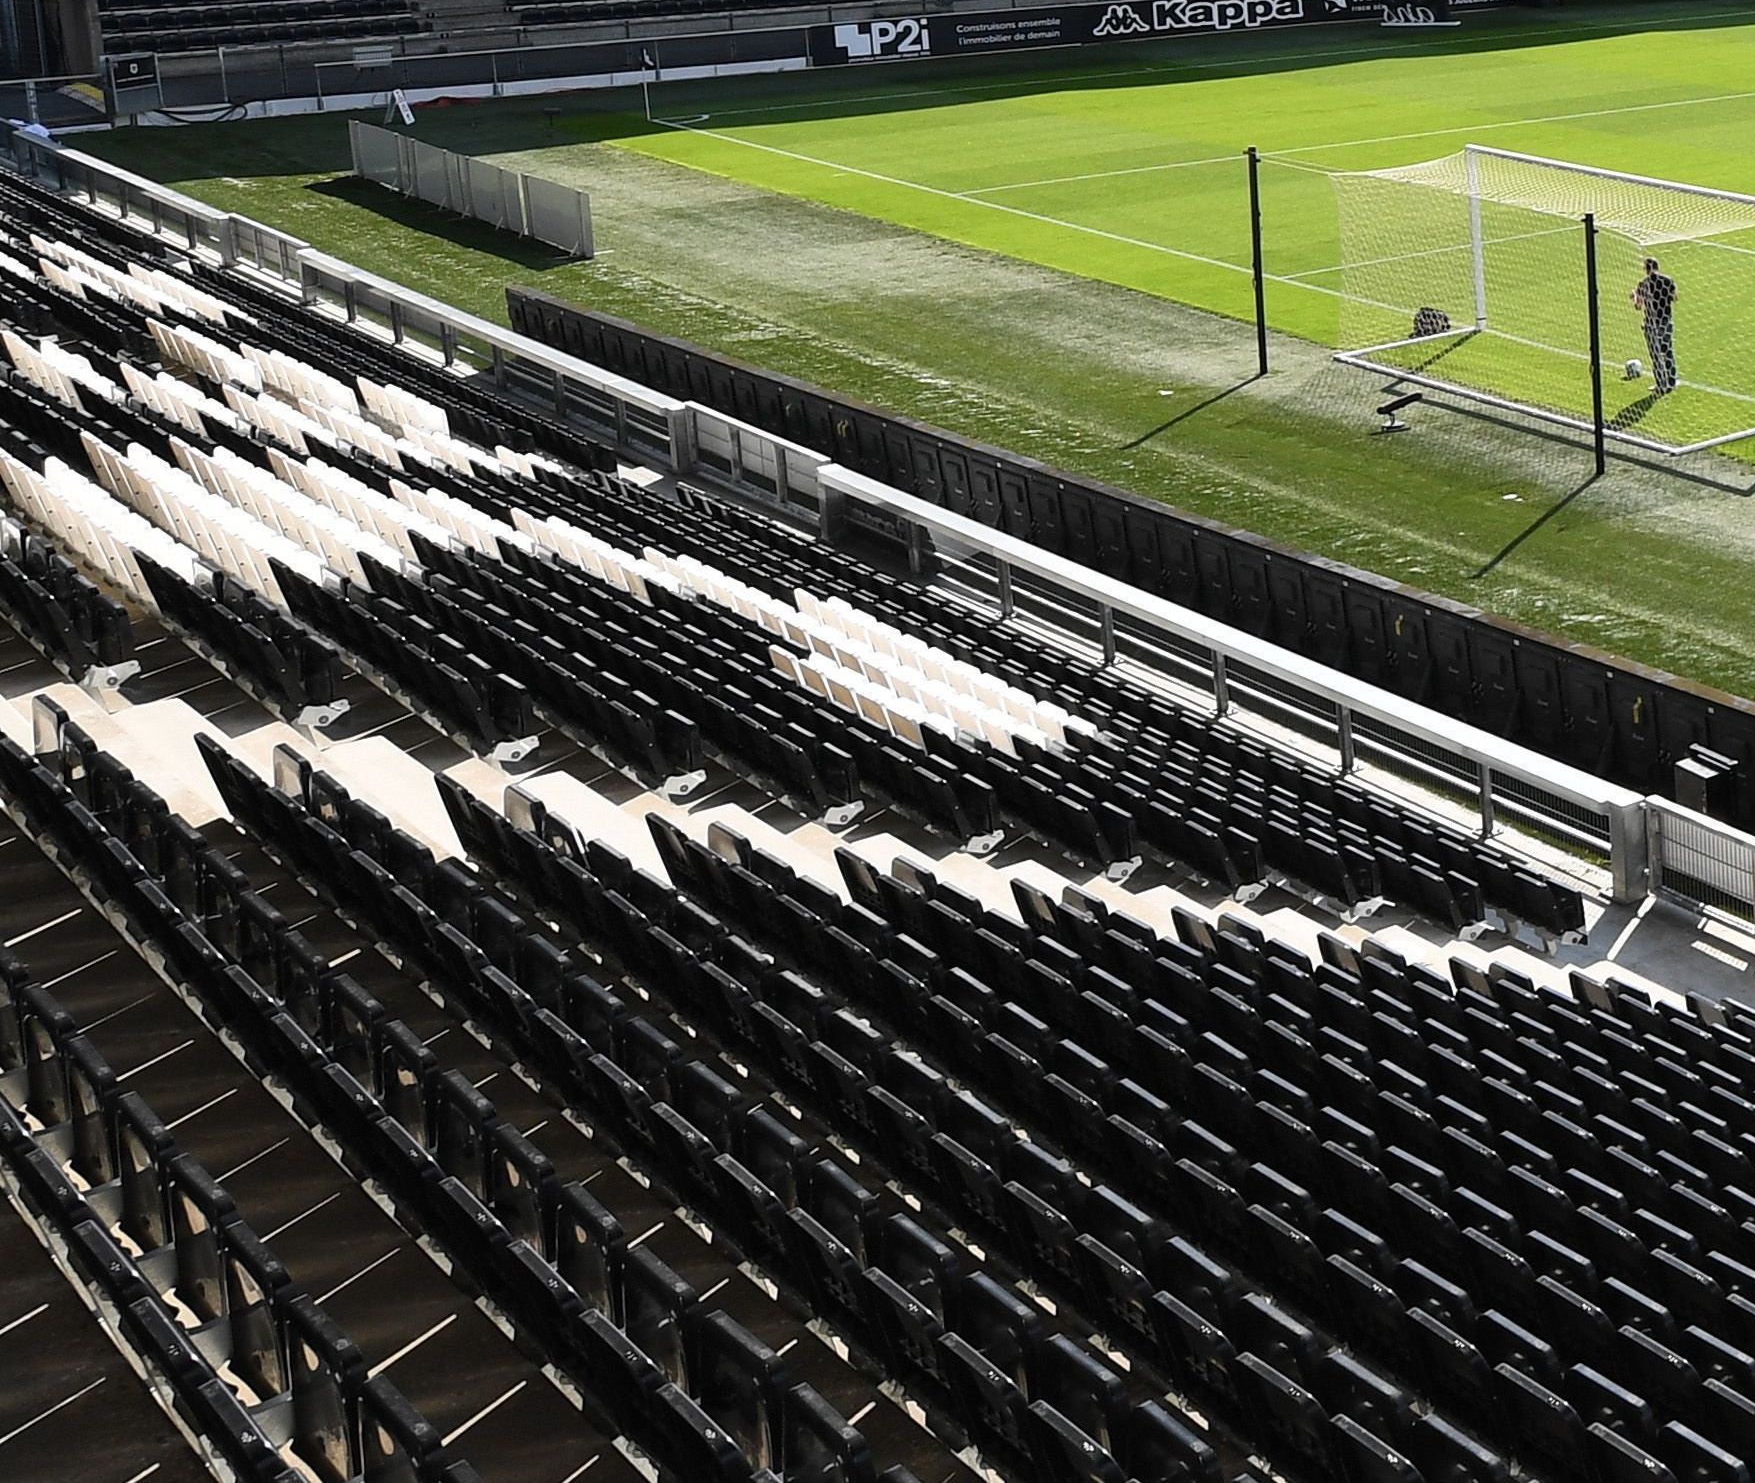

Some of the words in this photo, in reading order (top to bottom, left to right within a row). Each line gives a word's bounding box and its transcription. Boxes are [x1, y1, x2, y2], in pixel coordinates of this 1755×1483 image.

[956, 21, 1016, 34] Construisons
[1018, 17, 1061, 29] ensemble
[871, 18, 931, 54] P2i
[958, 32, 1012, 46] l'immobilier
[1014, 32, 1026, 42] de
[1027, 29, 1061, 41] demain
